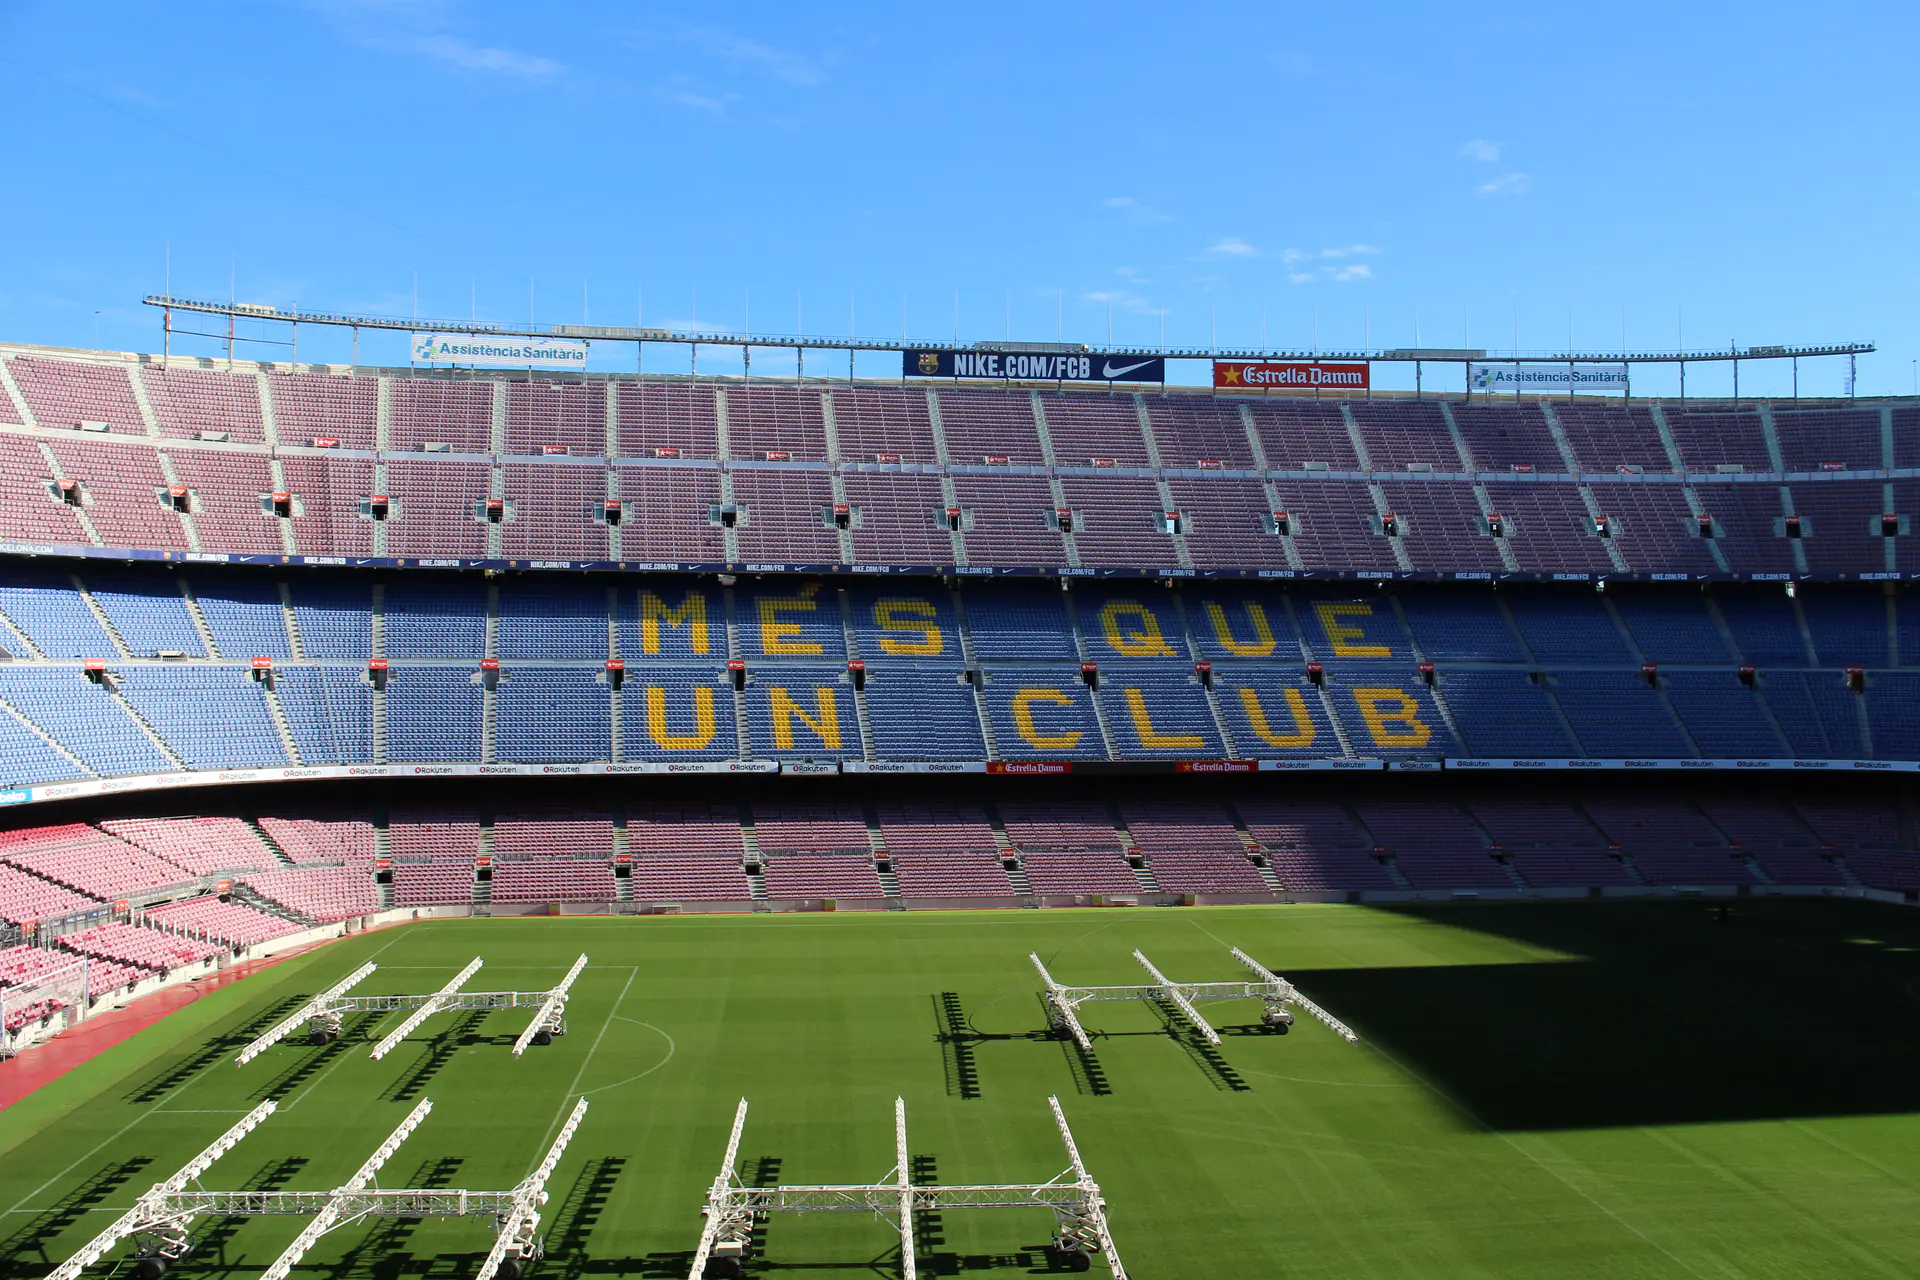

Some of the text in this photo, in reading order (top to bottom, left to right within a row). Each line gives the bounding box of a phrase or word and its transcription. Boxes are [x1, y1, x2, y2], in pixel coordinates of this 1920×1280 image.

[440, 342, 583, 360] Assistència Sanitària
[954, 354, 1090, 378] NIKE.COM/FCB
[1243, 366, 1362, 385] Estrella Damm
[1495, 370, 1628, 382] Assistència Sanitària
[0, 543, 54, 553] CELONA.COM
[186, 552, 229, 562] NIKE.COM/FCB
[304, 556, 346, 565] NIKE.COM/FCB
[419, 559, 459, 567] NIKE.COM/FCB
[530, 561, 570, 569] NIKE.COM/FCB
[639, 563, 678, 571] NIKE.COM/FCB
[746, 564, 784, 572] NIKE.COM/FCB
[852, 565, 889, 573] NIKE.COM/FCB
[1159, 569, 1195, 577] NIKE.COM/FCB
[1357, 571, 1393, 579] NIKE.COM/FCB
[1455, 572, 1491, 580] NIKE.COM/FCB
[1860, 572, 1900, 580] NIKE.COM/FCB
[1101, 602, 1392, 657] QUE
[644, 685, 1432, 750] UN CLUB
[1005, 764, 1064, 772] Estrella Damm
[1192, 763, 1249, 771] Estrella Damm
